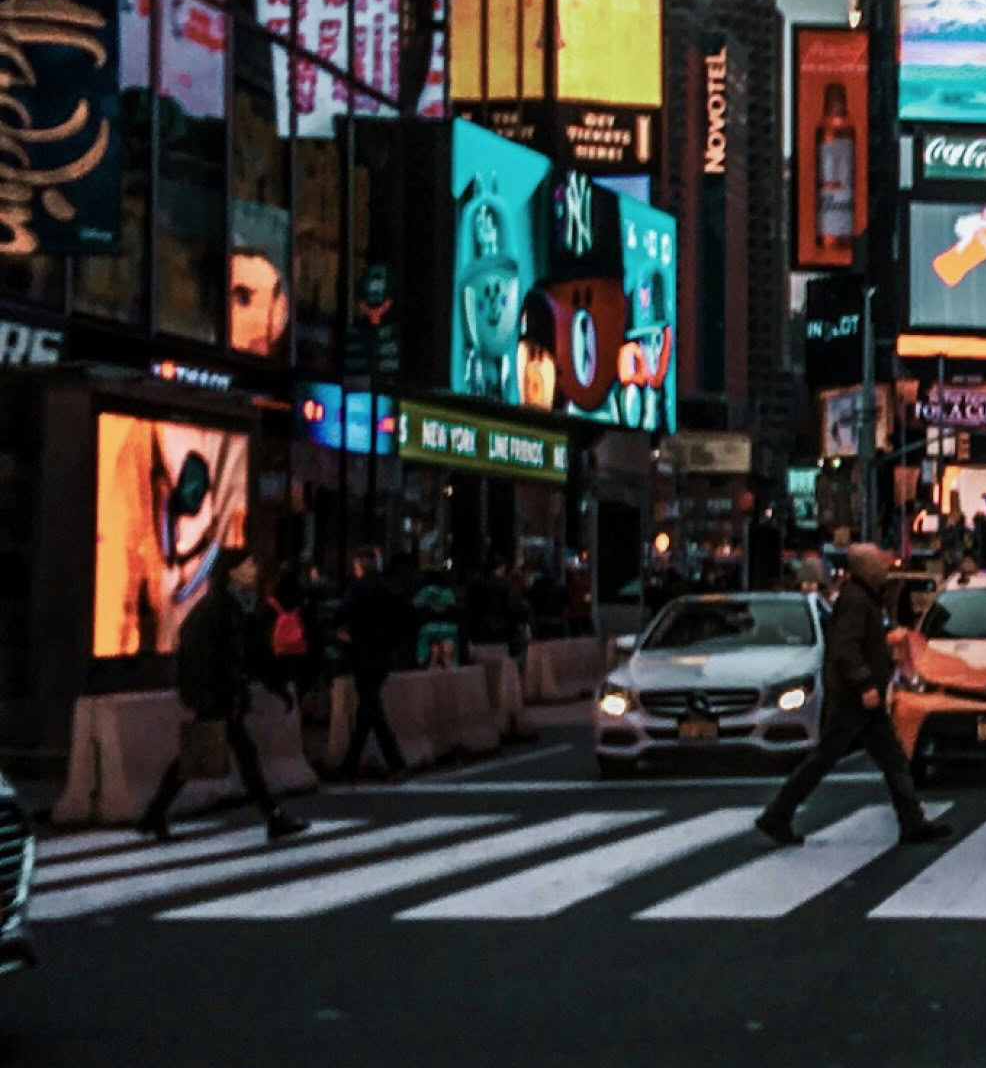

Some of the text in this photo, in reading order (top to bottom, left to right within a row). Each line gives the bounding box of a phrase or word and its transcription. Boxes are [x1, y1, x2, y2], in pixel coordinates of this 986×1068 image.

[704, 46, 727, 173] NOVOTEL
[422, 417, 448, 453] NEW
[450, 423, 477, 457] YORK
